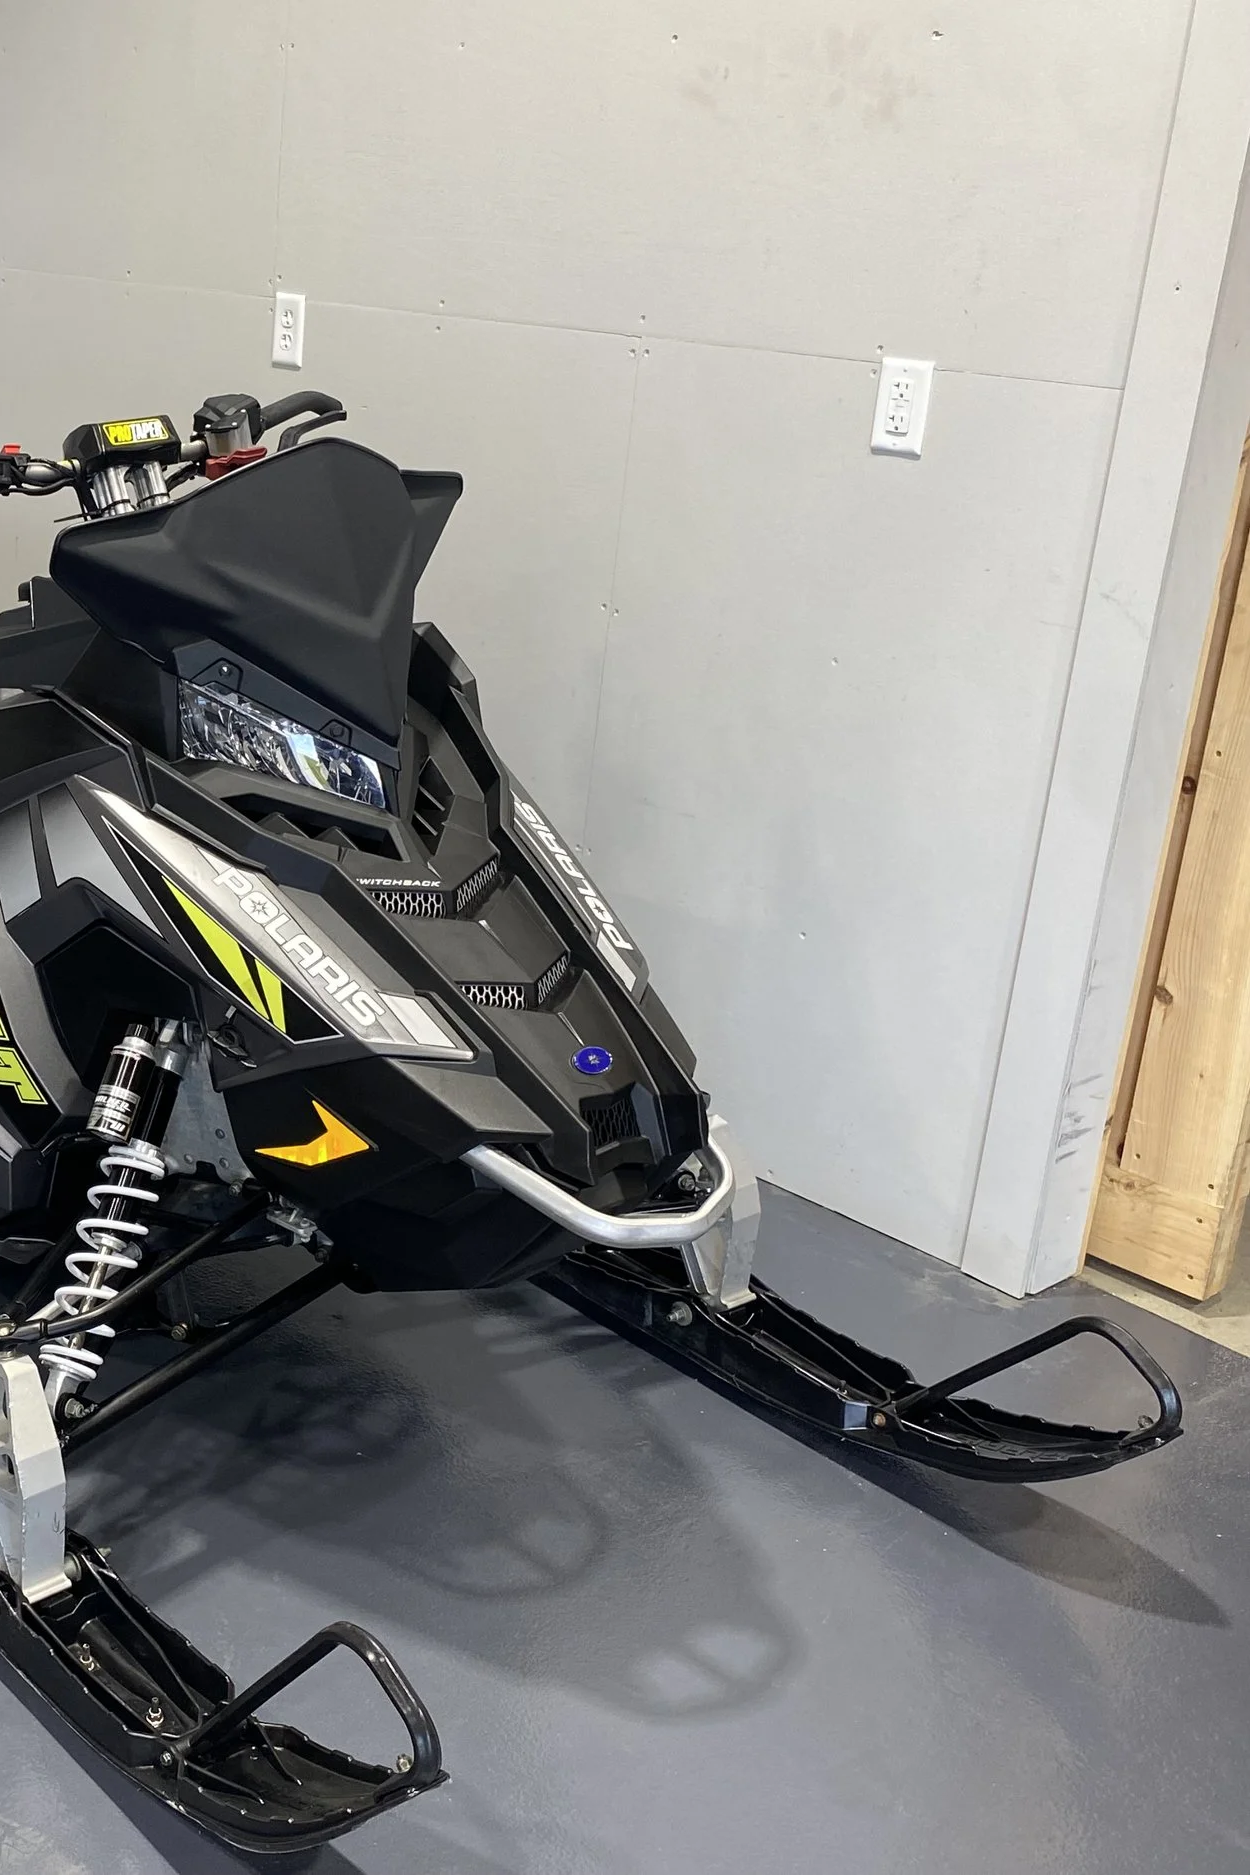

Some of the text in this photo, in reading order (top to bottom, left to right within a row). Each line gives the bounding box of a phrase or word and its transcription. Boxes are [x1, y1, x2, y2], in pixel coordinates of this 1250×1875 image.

[212, 866, 387, 1028] POLARIS
[356, 878, 442, 888] WITCHBACK
[520, 802, 634, 950] POLARIS
